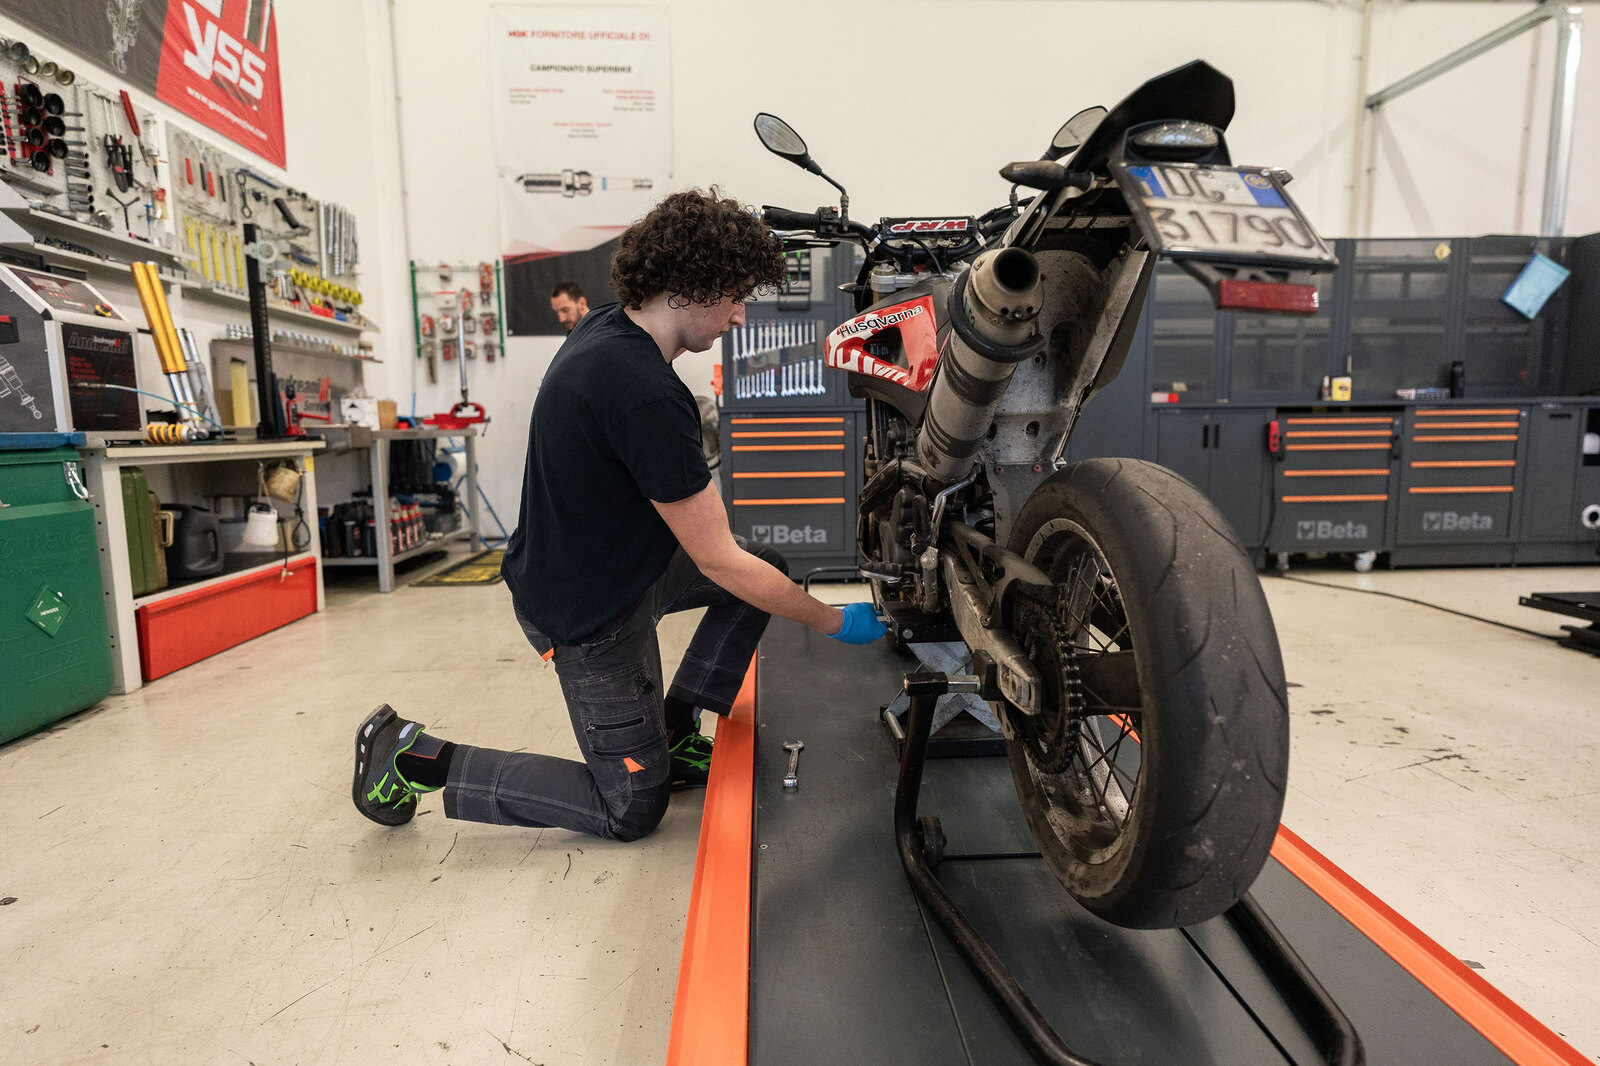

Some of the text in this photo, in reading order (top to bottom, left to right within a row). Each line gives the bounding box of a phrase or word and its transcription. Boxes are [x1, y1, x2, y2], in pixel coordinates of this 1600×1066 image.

[531, 31, 585, 40] FORNITORE
[588, 31, 637, 41] UFFICIALE
[529, 64, 632, 73] CAMPIONATO SUPERBIKE
[890, 218, 969, 233] WRP
[1147, 207, 1315, 250] 31790
[838, 304, 923, 338] Husqvarna
[1316, 520, 1368, 539] Beta
[1442, 511, 1493, 531] Beta
[772, 524, 828, 544] Beta
